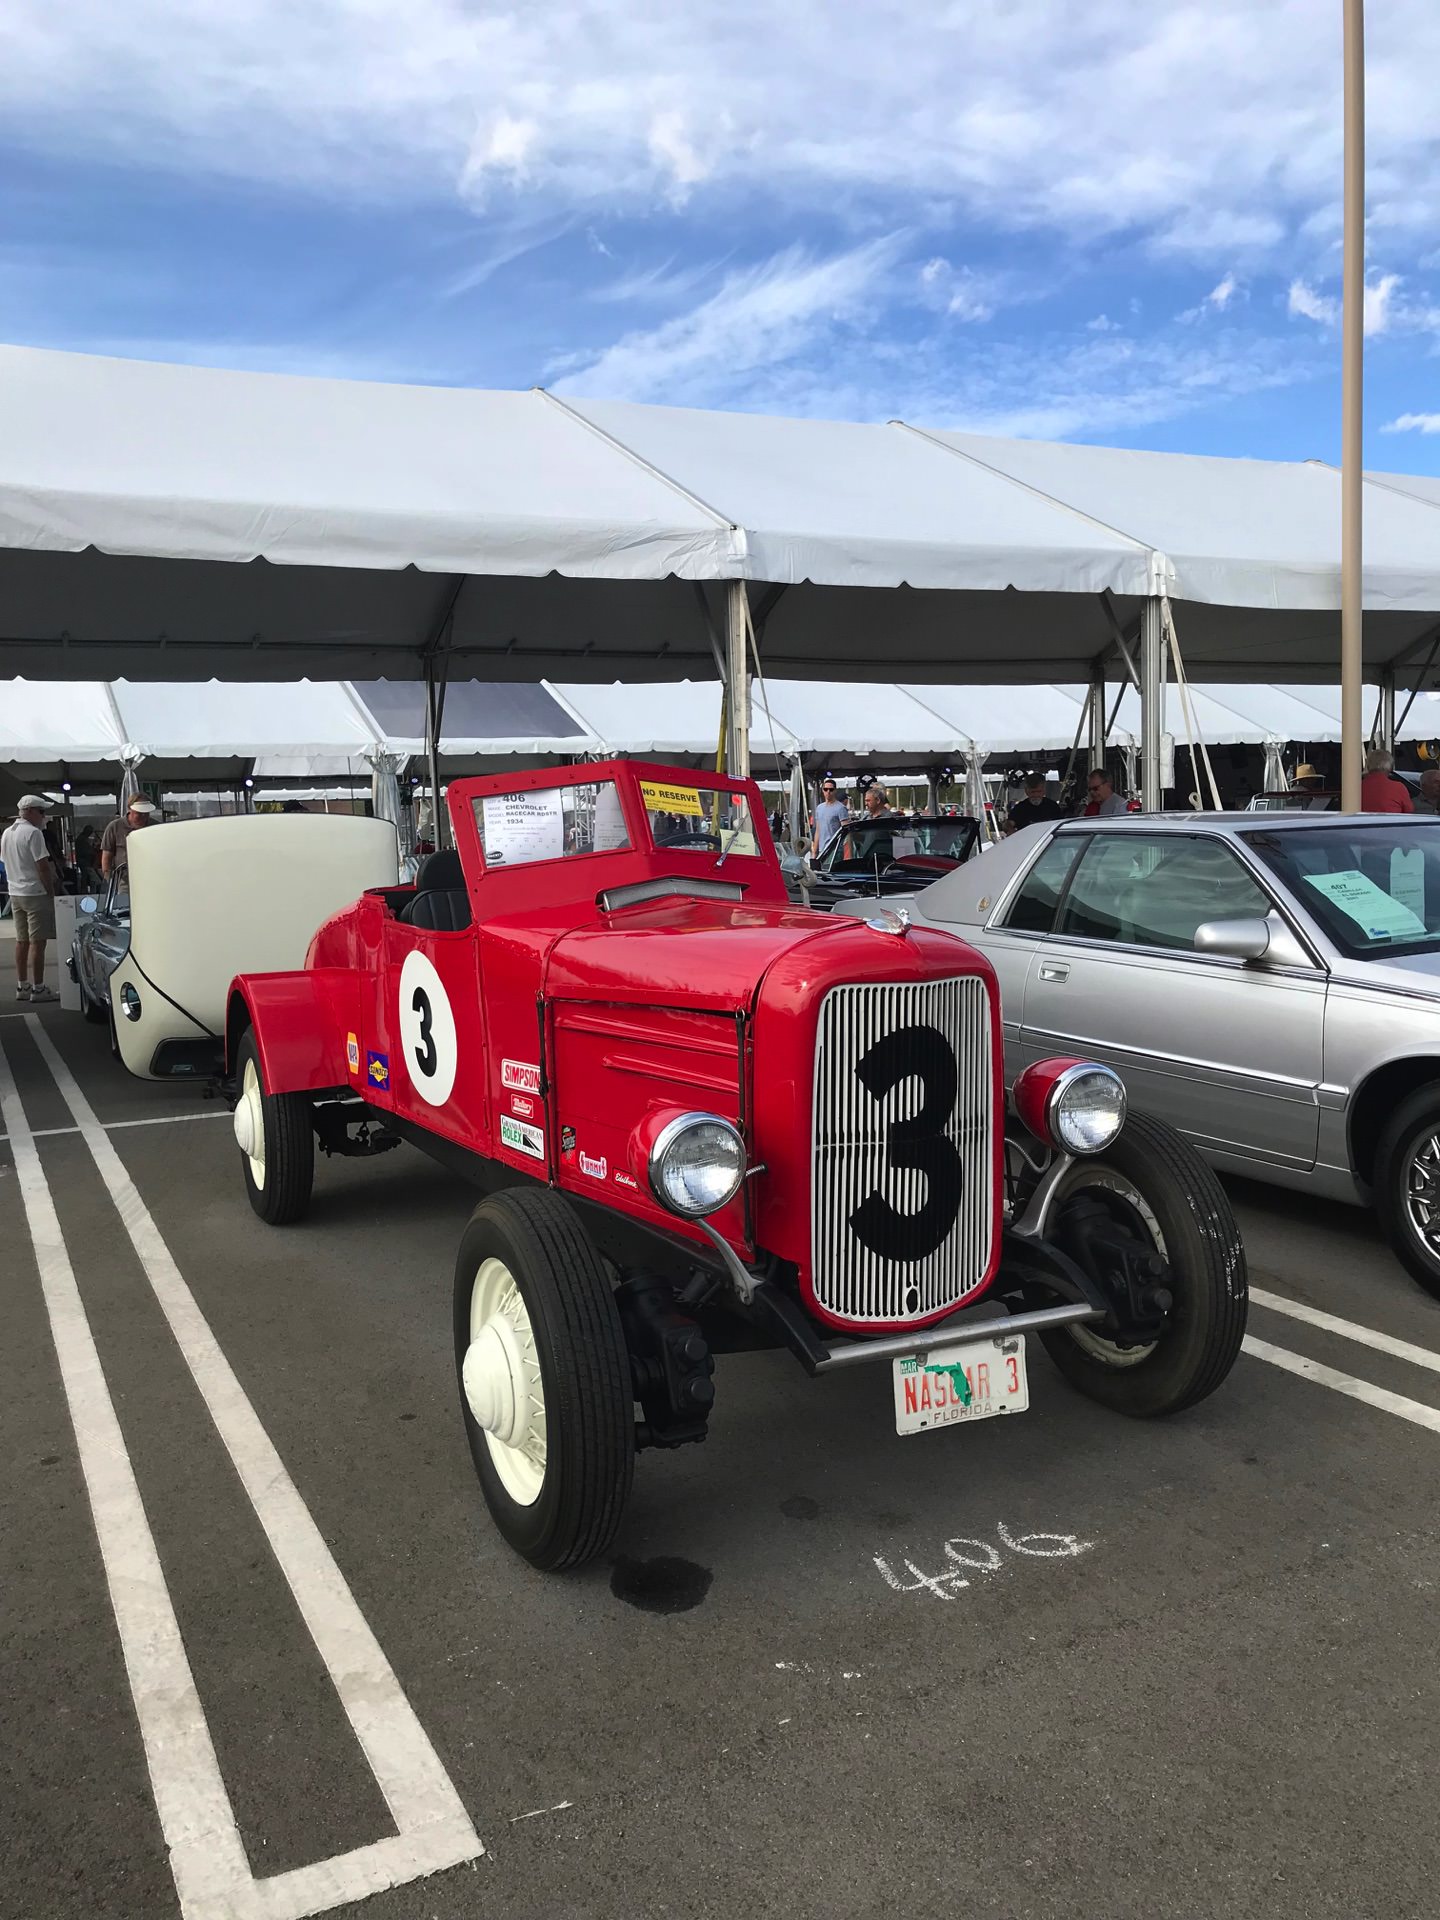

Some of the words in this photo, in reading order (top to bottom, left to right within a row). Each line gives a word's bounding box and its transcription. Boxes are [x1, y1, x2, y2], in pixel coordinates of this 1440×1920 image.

[503, 794, 526, 803] 406
[642, 788, 656, 797] NO
[659, 789, 698, 803] RESERVE
[412, 986, 437, 1078] 3
[369, 1065, 388, 1078] SUNOCO
[504, 1064, 541, 1090] SIMPSON
[502, 1126, 522, 1145] ROLEX
[850, 1024, 962, 1262] 3
[901, 1361, 917, 1373] MAR
[1006, 1357, 1019, 1394] 3
[933, 1402, 992, 1423] FLORIDA
[873, 1522, 1095, 1600] 406
